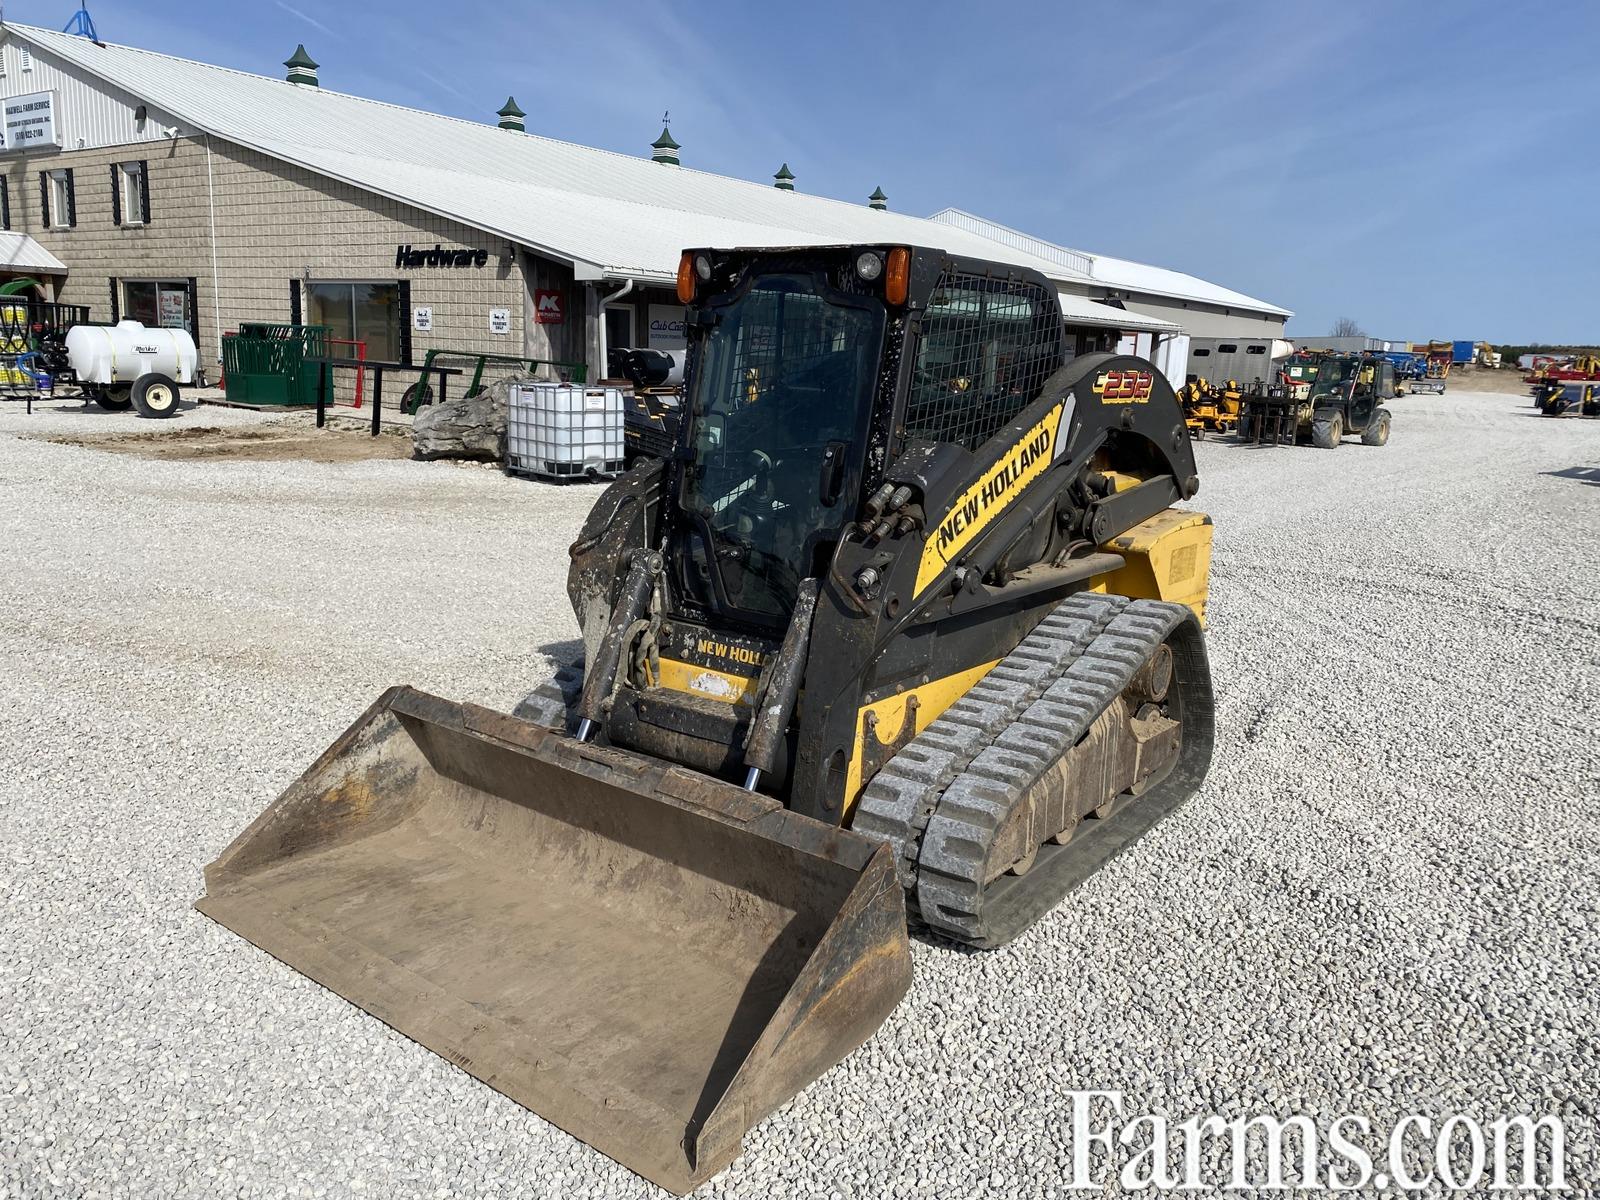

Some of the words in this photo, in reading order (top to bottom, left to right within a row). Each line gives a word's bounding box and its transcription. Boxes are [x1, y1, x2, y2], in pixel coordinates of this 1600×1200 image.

[34, 100, 50, 110] SERVICE
[396, 245, 488, 268] Hardware
[651, 320, 667, 331] Cub
[939, 495, 979, 549] NEW
[981, 429, 1050, 509] HOLLAND
[697, 638, 727, 657] NEW
